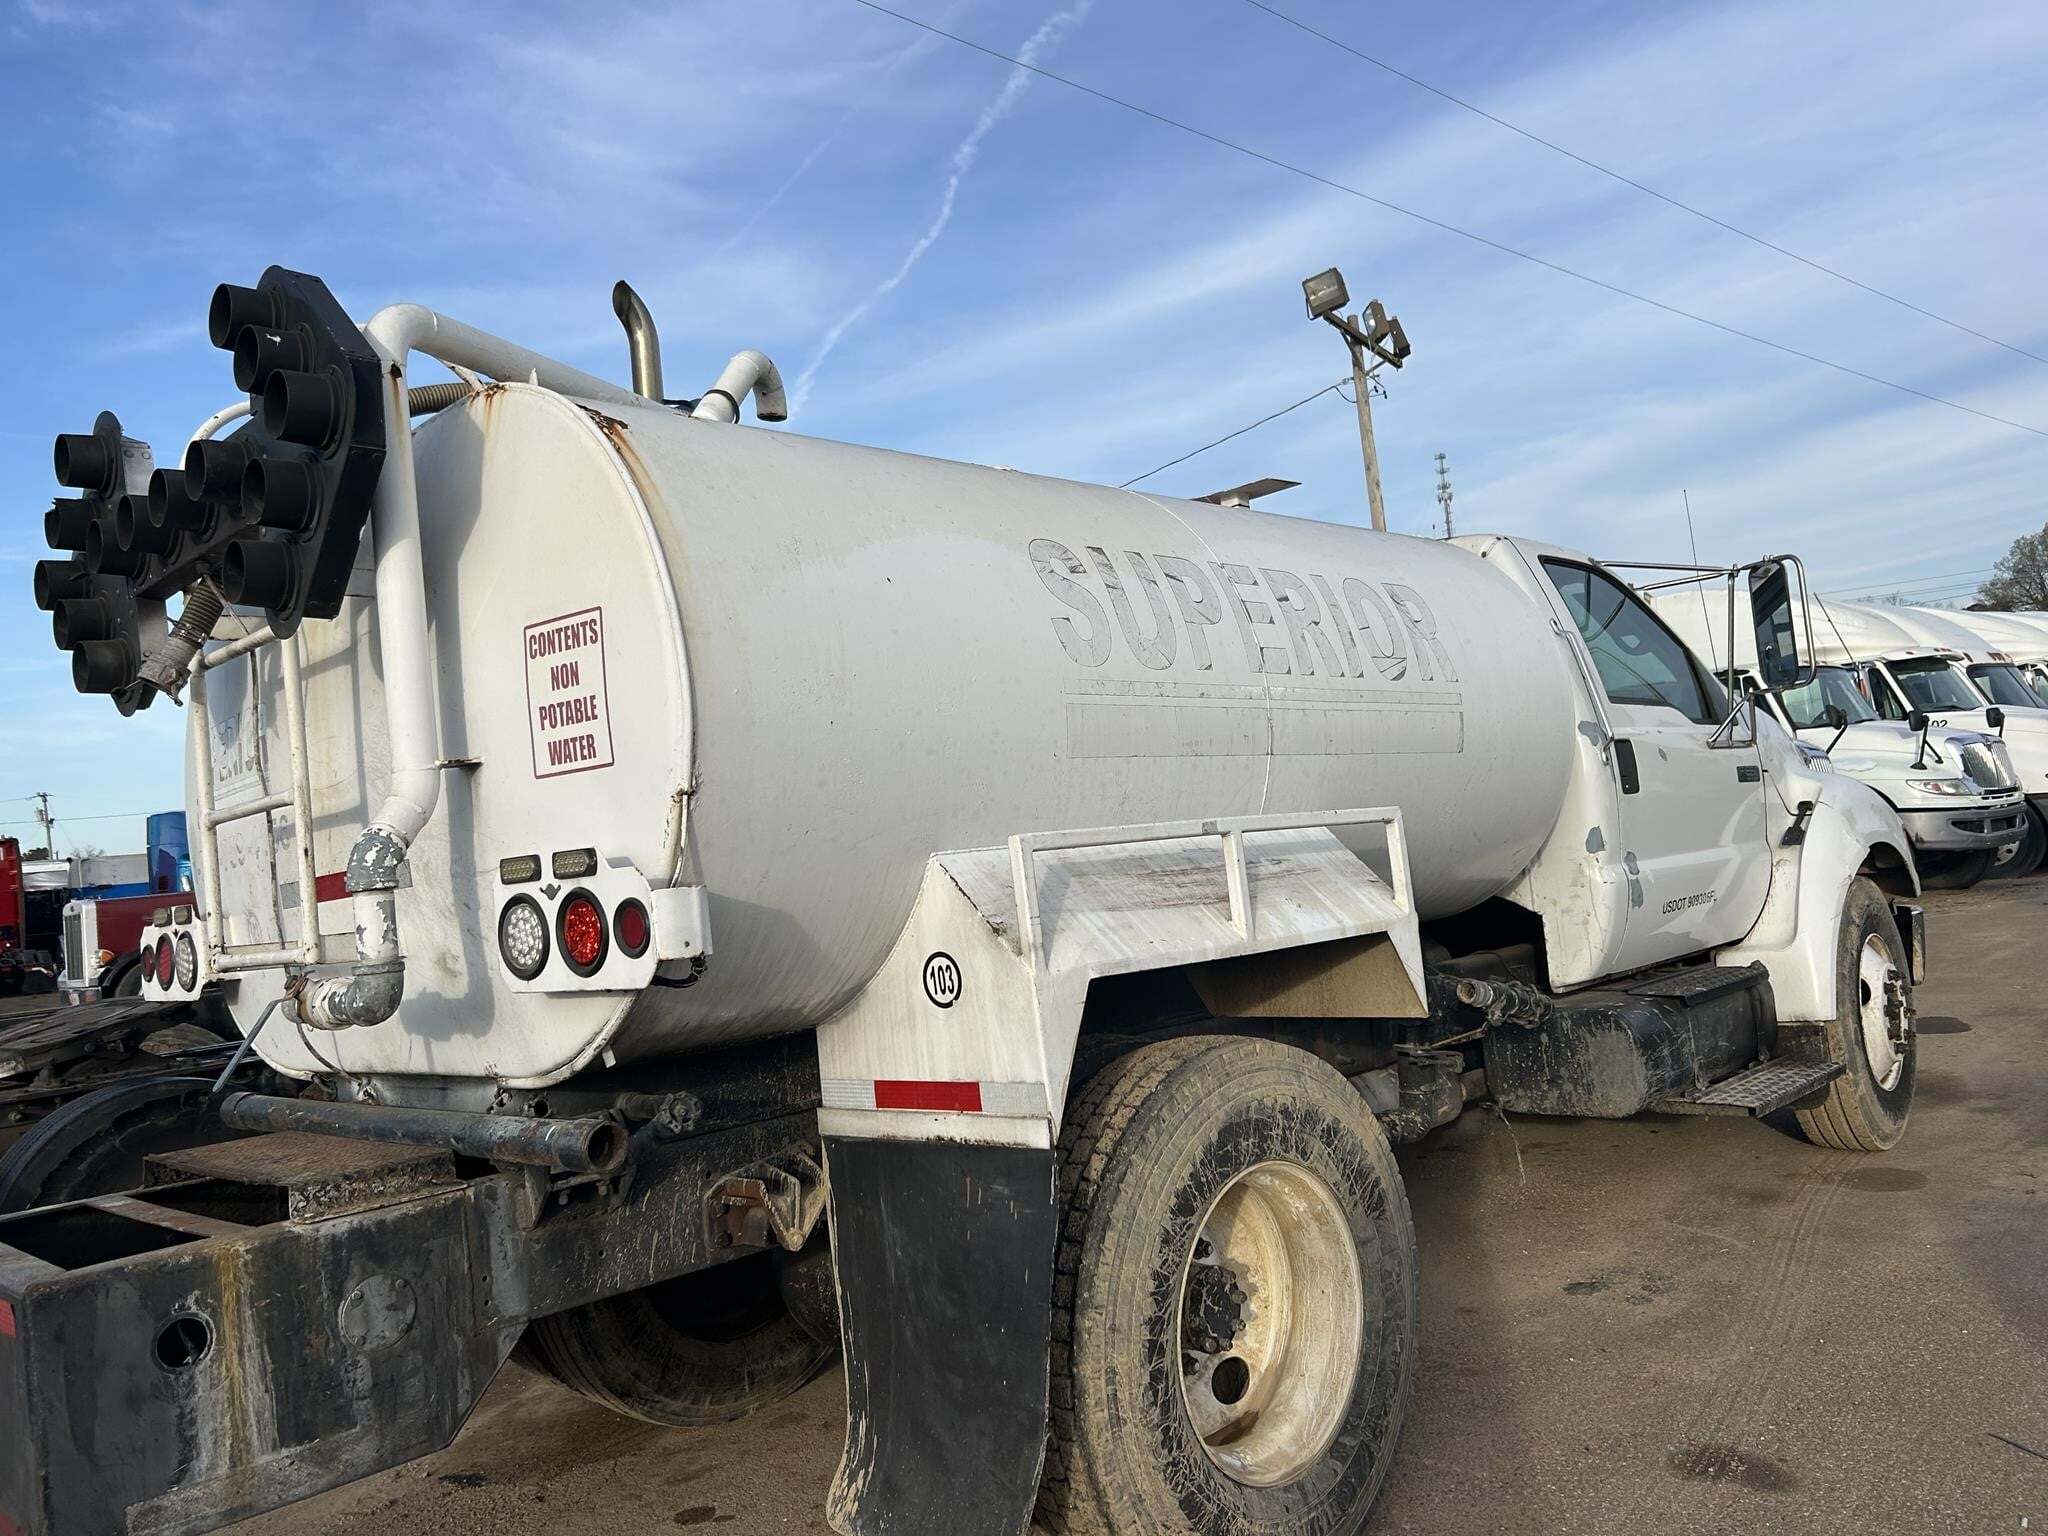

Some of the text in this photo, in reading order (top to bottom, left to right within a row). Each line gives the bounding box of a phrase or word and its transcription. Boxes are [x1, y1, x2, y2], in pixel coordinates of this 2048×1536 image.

[1028, 538, 1459, 682] SUPERIOR
[528, 618, 599, 660] CONTENTS
[550, 661, 580, 691] NON
[539, 695, 598, 731] POTABLE
[548, 733, 597, 766] WATER
[1662, 896, 1687, 914] USDOT
[930, 964, 955, 995] 103
